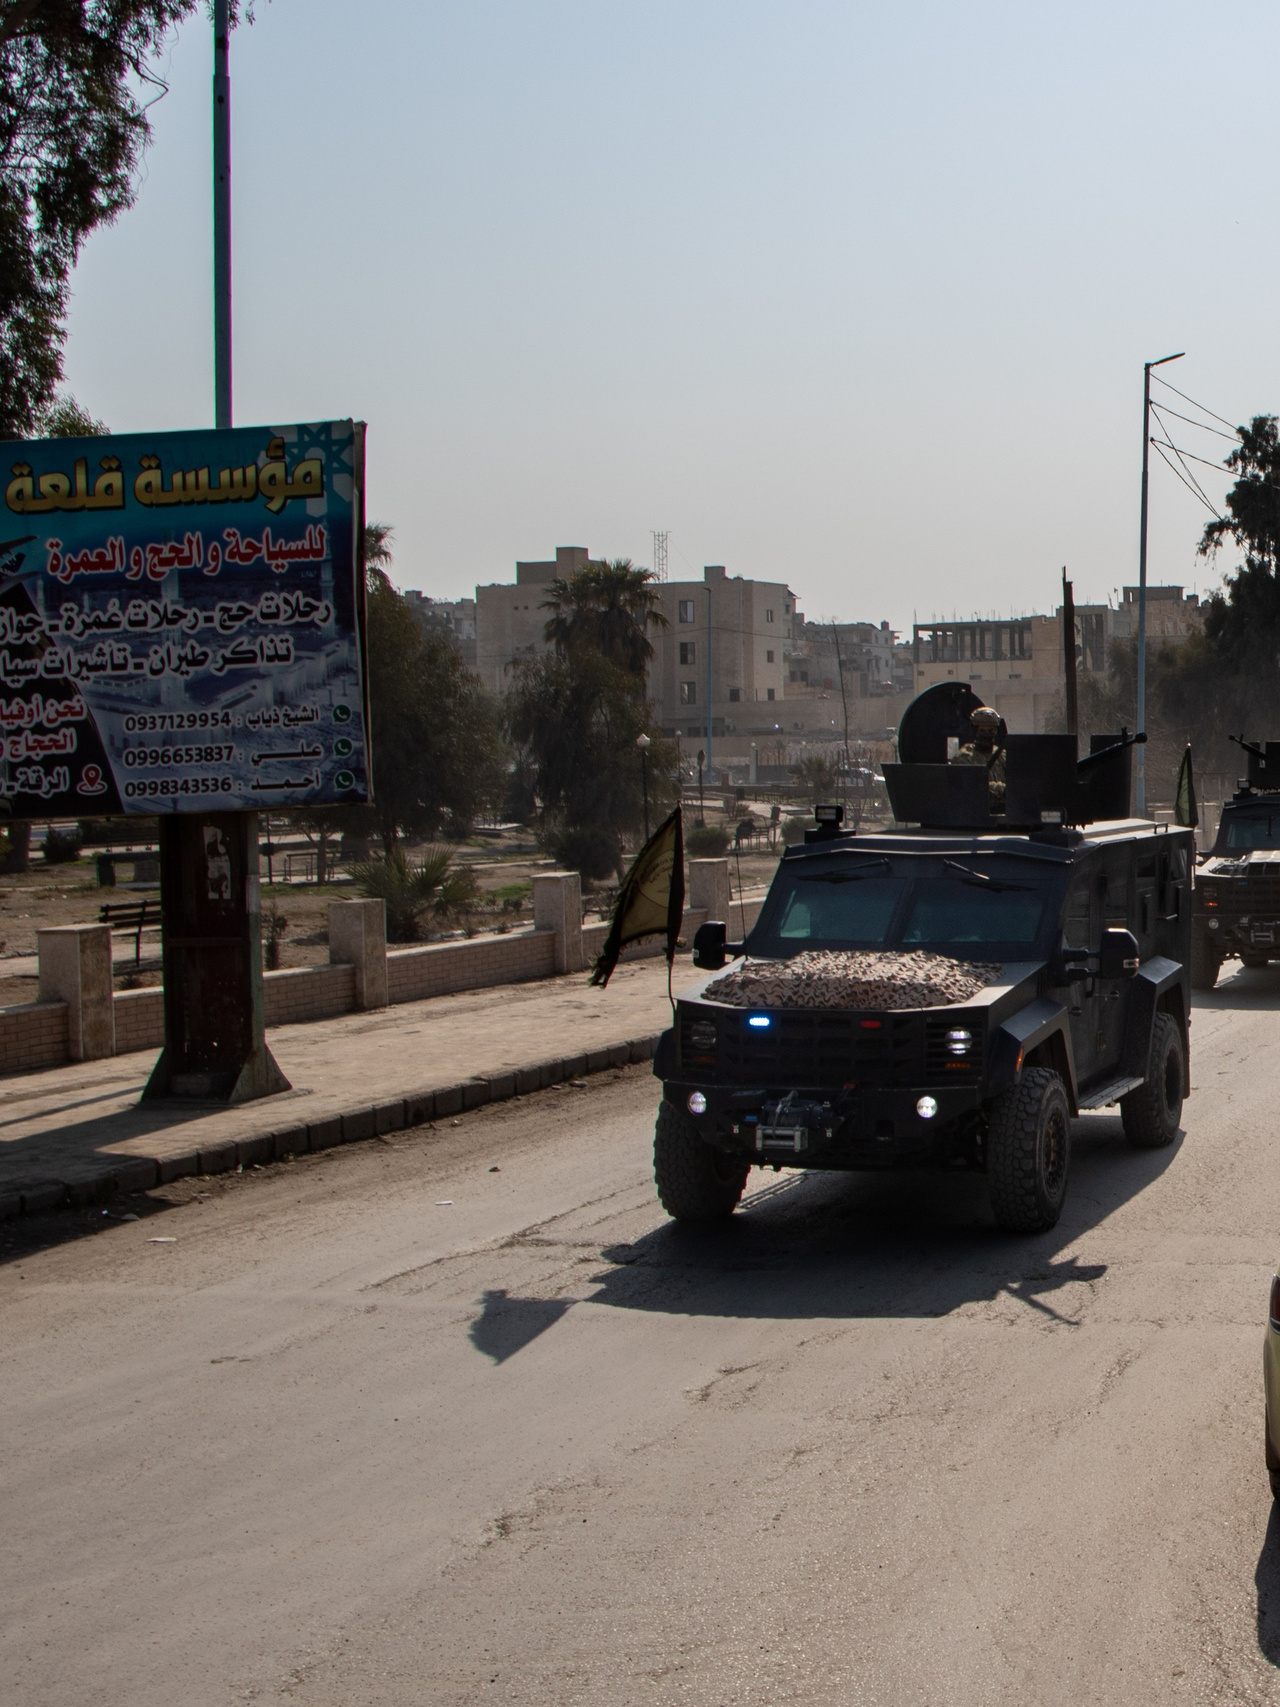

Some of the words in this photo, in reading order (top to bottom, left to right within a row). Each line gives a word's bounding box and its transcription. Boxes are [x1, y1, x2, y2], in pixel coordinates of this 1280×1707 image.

[5, 456, 126, 515] قلعة
[134, 437, 324, 515] مؤسسة
[47, 535, 126, 584] العمرة
[125, 546, 144, 580] و
[148, 531, 204, 581] الحج
[203, 541, 222, 576] و
[224, 525, 327, 573] للسياحة
[127, 600, 200, 632] رحلات
[217, 602, 254, 631] حج
[259, 593, 332, 625] رحلات
[148, 642, 211, 677] طيران
[212, 636, 293, 674] تذاكر
[45, 697, 86, 725] نحن
[124, 711, 232, 732] 0937129954
[247, 708, 281, 729] ذياب
[283, 706, 320, 727] الشيخ
[8, 730, 76, 760] الحجاج
[124, 745, 234, 766] 0996653837
[17, 767, 69, 797] الرقة
[124, 777, 233, 797] 0998343536
[251, 769, 320, 791] أحمد
